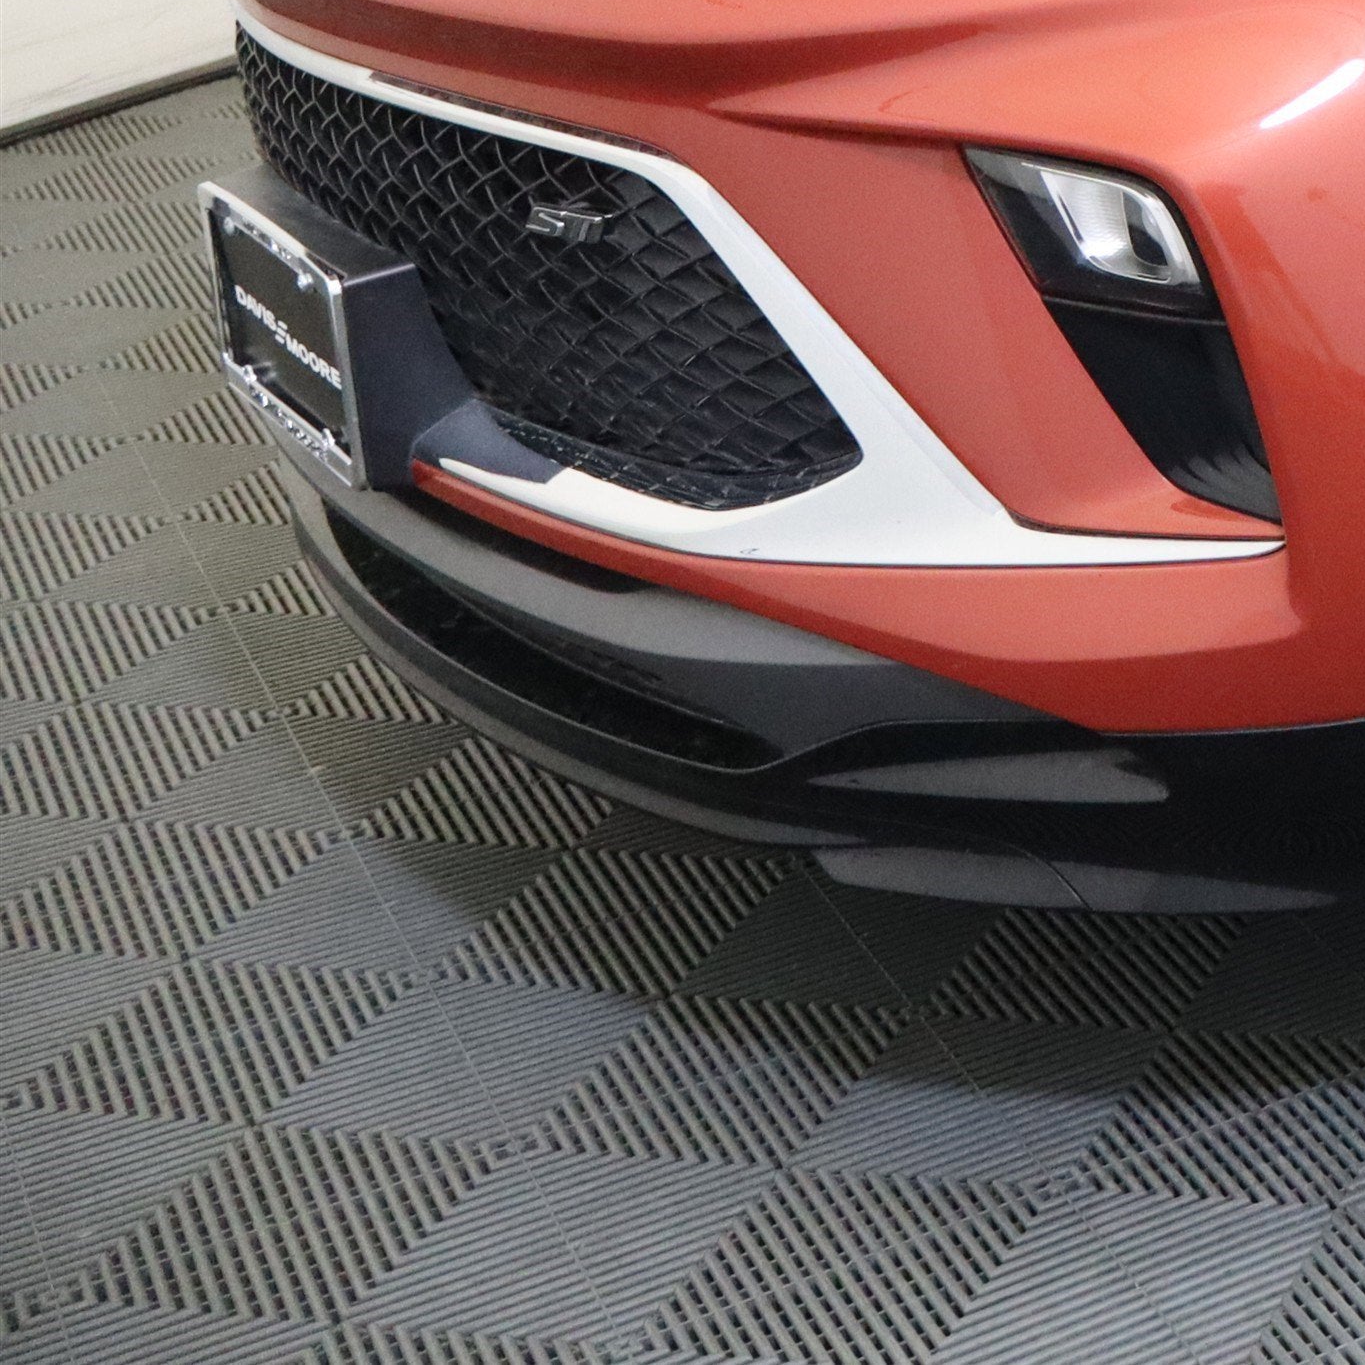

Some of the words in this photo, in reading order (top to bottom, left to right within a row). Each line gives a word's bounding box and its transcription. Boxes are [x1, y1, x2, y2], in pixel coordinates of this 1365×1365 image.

[525, 206, 604, 243] ST
[234, 284, 278, 331] DAVIS
[285, 336, 343, 390] MOORE
